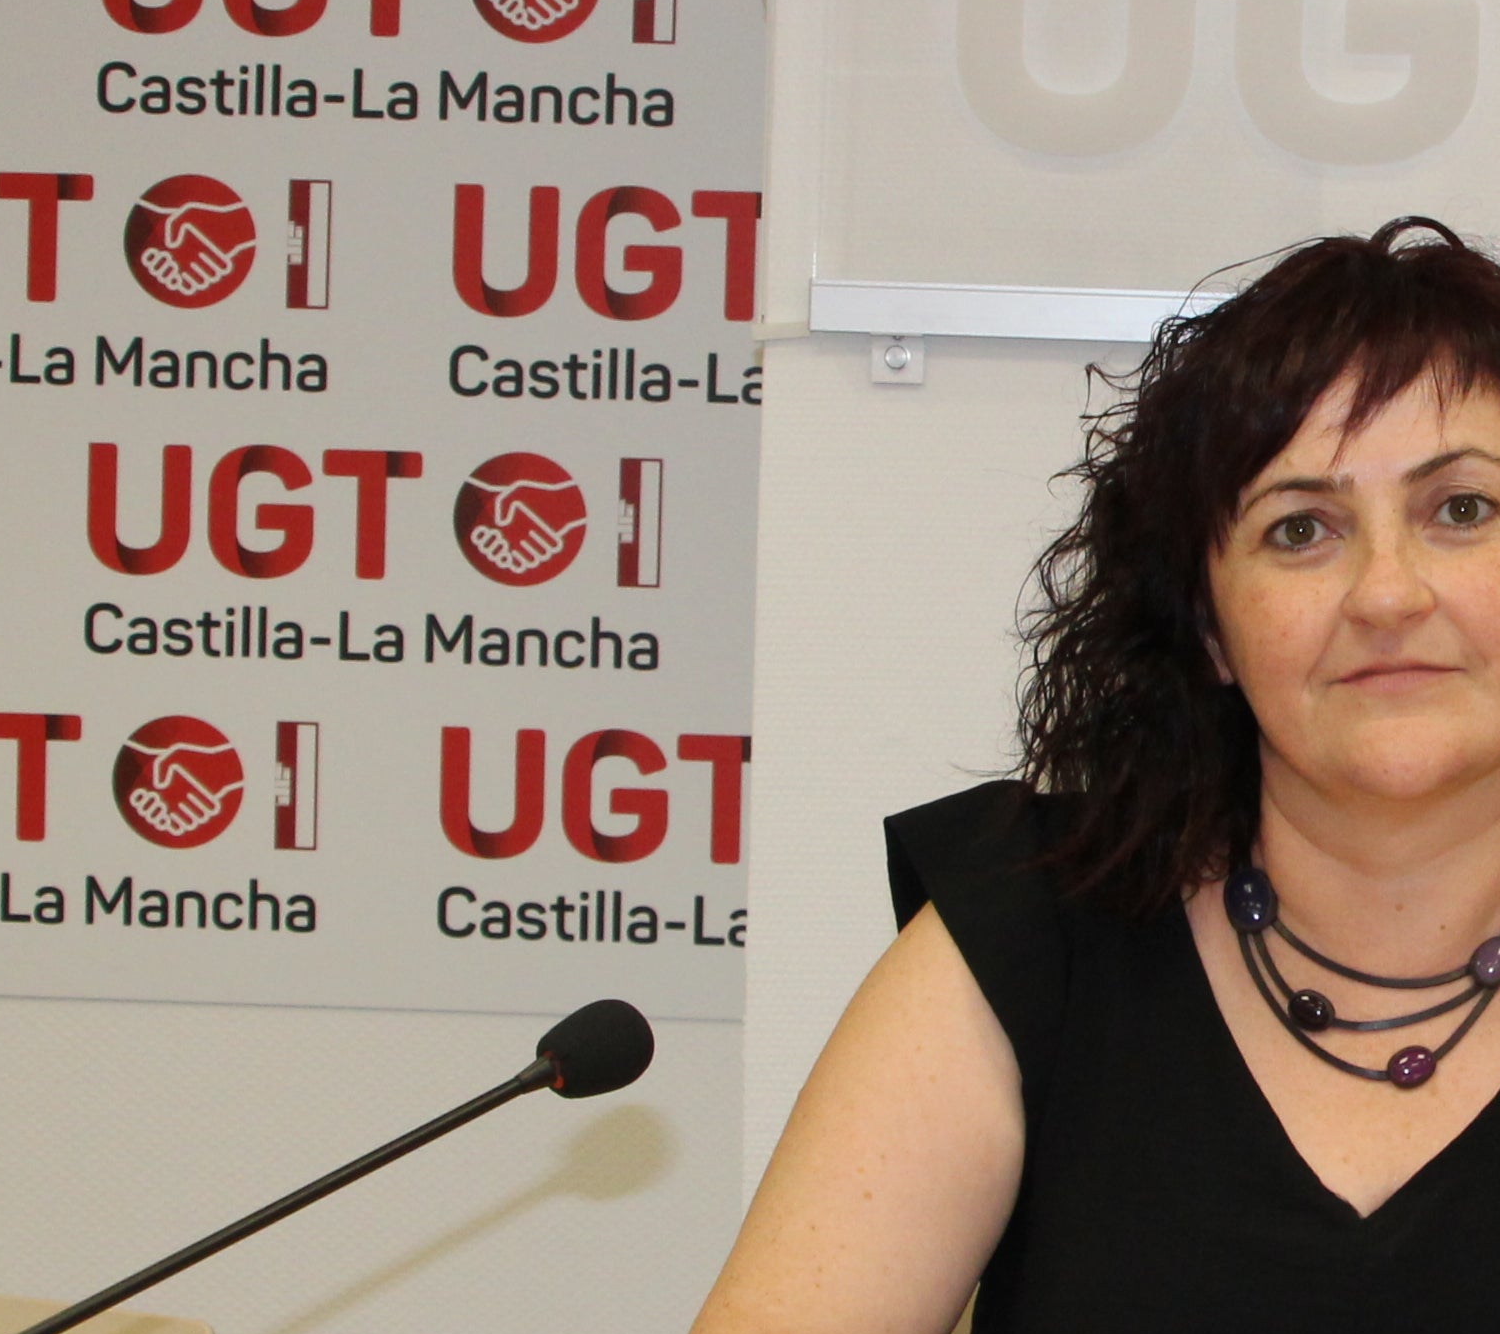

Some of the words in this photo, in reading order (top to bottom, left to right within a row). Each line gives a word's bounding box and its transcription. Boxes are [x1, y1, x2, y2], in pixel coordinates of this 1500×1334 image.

[98, 62, 418, 120] Castilla-La
[440, 71, 674, 127] Mancha
[453, 184, 762, 321] UGT
[96, 336, 327, 392] Mancha
[87, 443, 423, 579] UGT
[85, 603, 404, 663] Castilla-La
[426, 614, 659, 671] Mancha
[440, 726, 752, 864] UGT
[86, 875, 316, 933] Mancha
